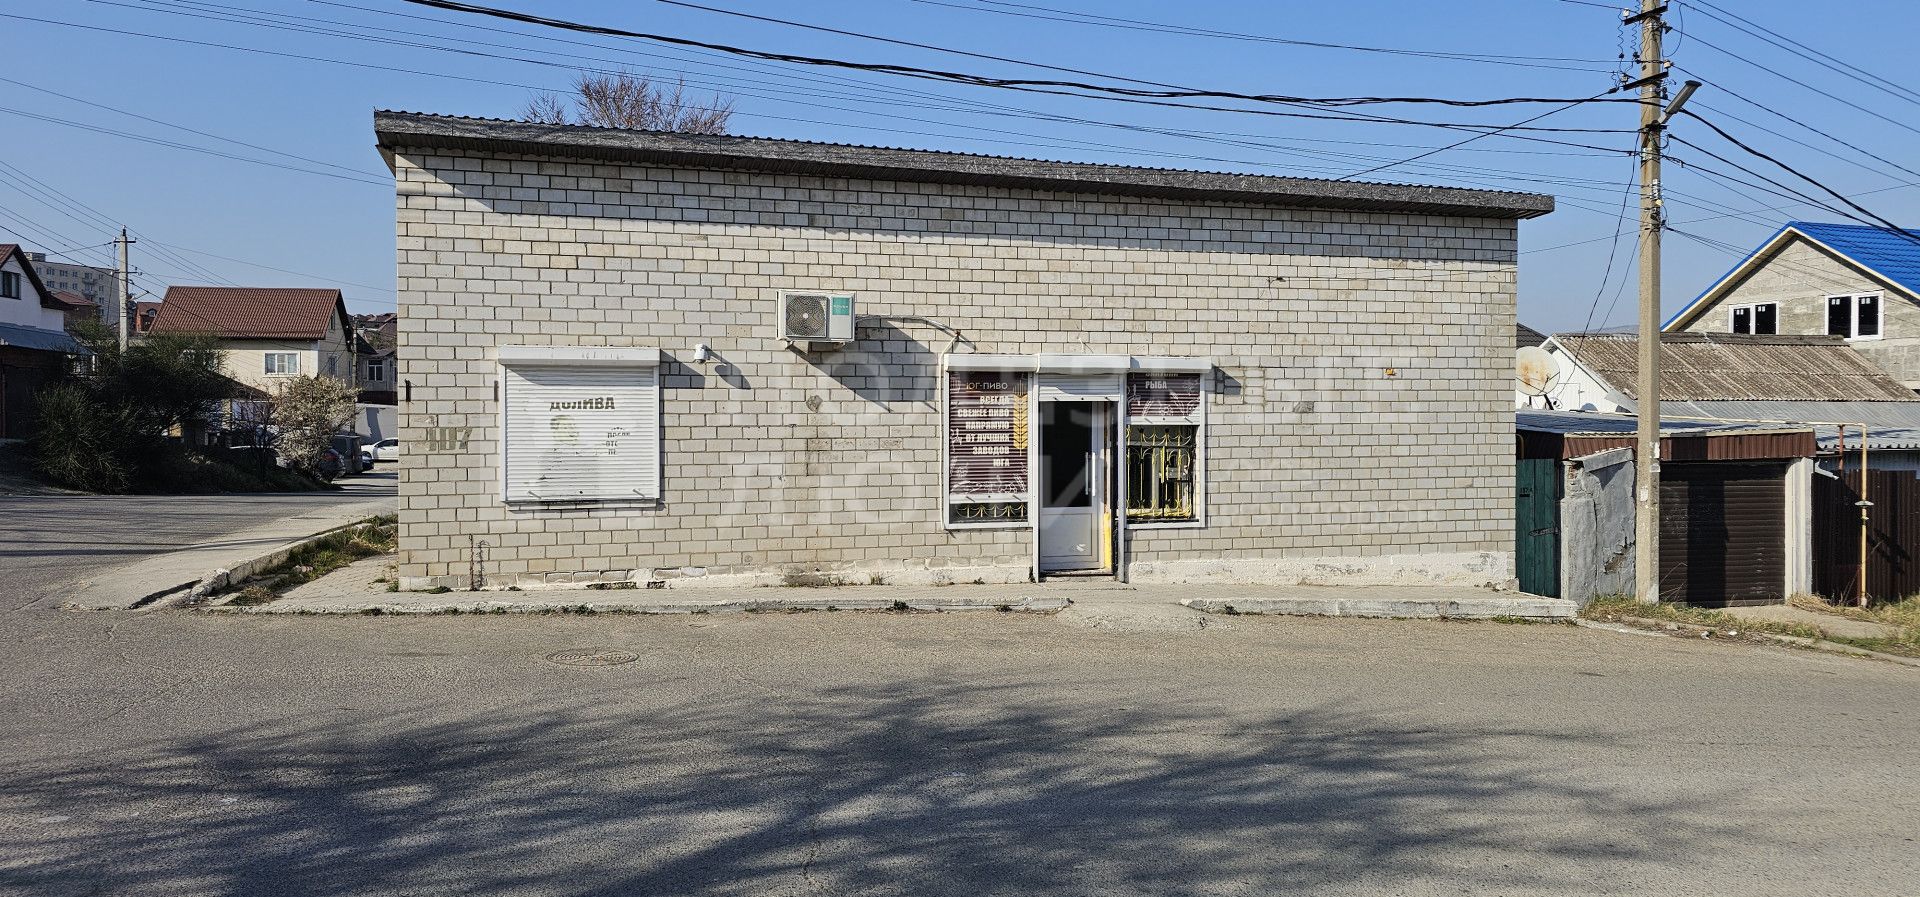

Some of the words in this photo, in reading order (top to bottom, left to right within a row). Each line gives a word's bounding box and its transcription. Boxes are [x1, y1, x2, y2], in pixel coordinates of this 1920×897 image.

[1145, 381, 1167, 389] РЫБА
[980, 395, 1010, 405] ВСЕГДА
[988, 408, 1010, 417] ПИВО
[965, 421, 1010, 430] НАПРЯМУЮ
[965, 434, 975, 442] ОТ
[977, 434, 1010, 442] ЛУЧШИХ
[972, 446, 1010, 455] ЗАВОДОВ
[993, 459, 1010, 467] ЮГА
